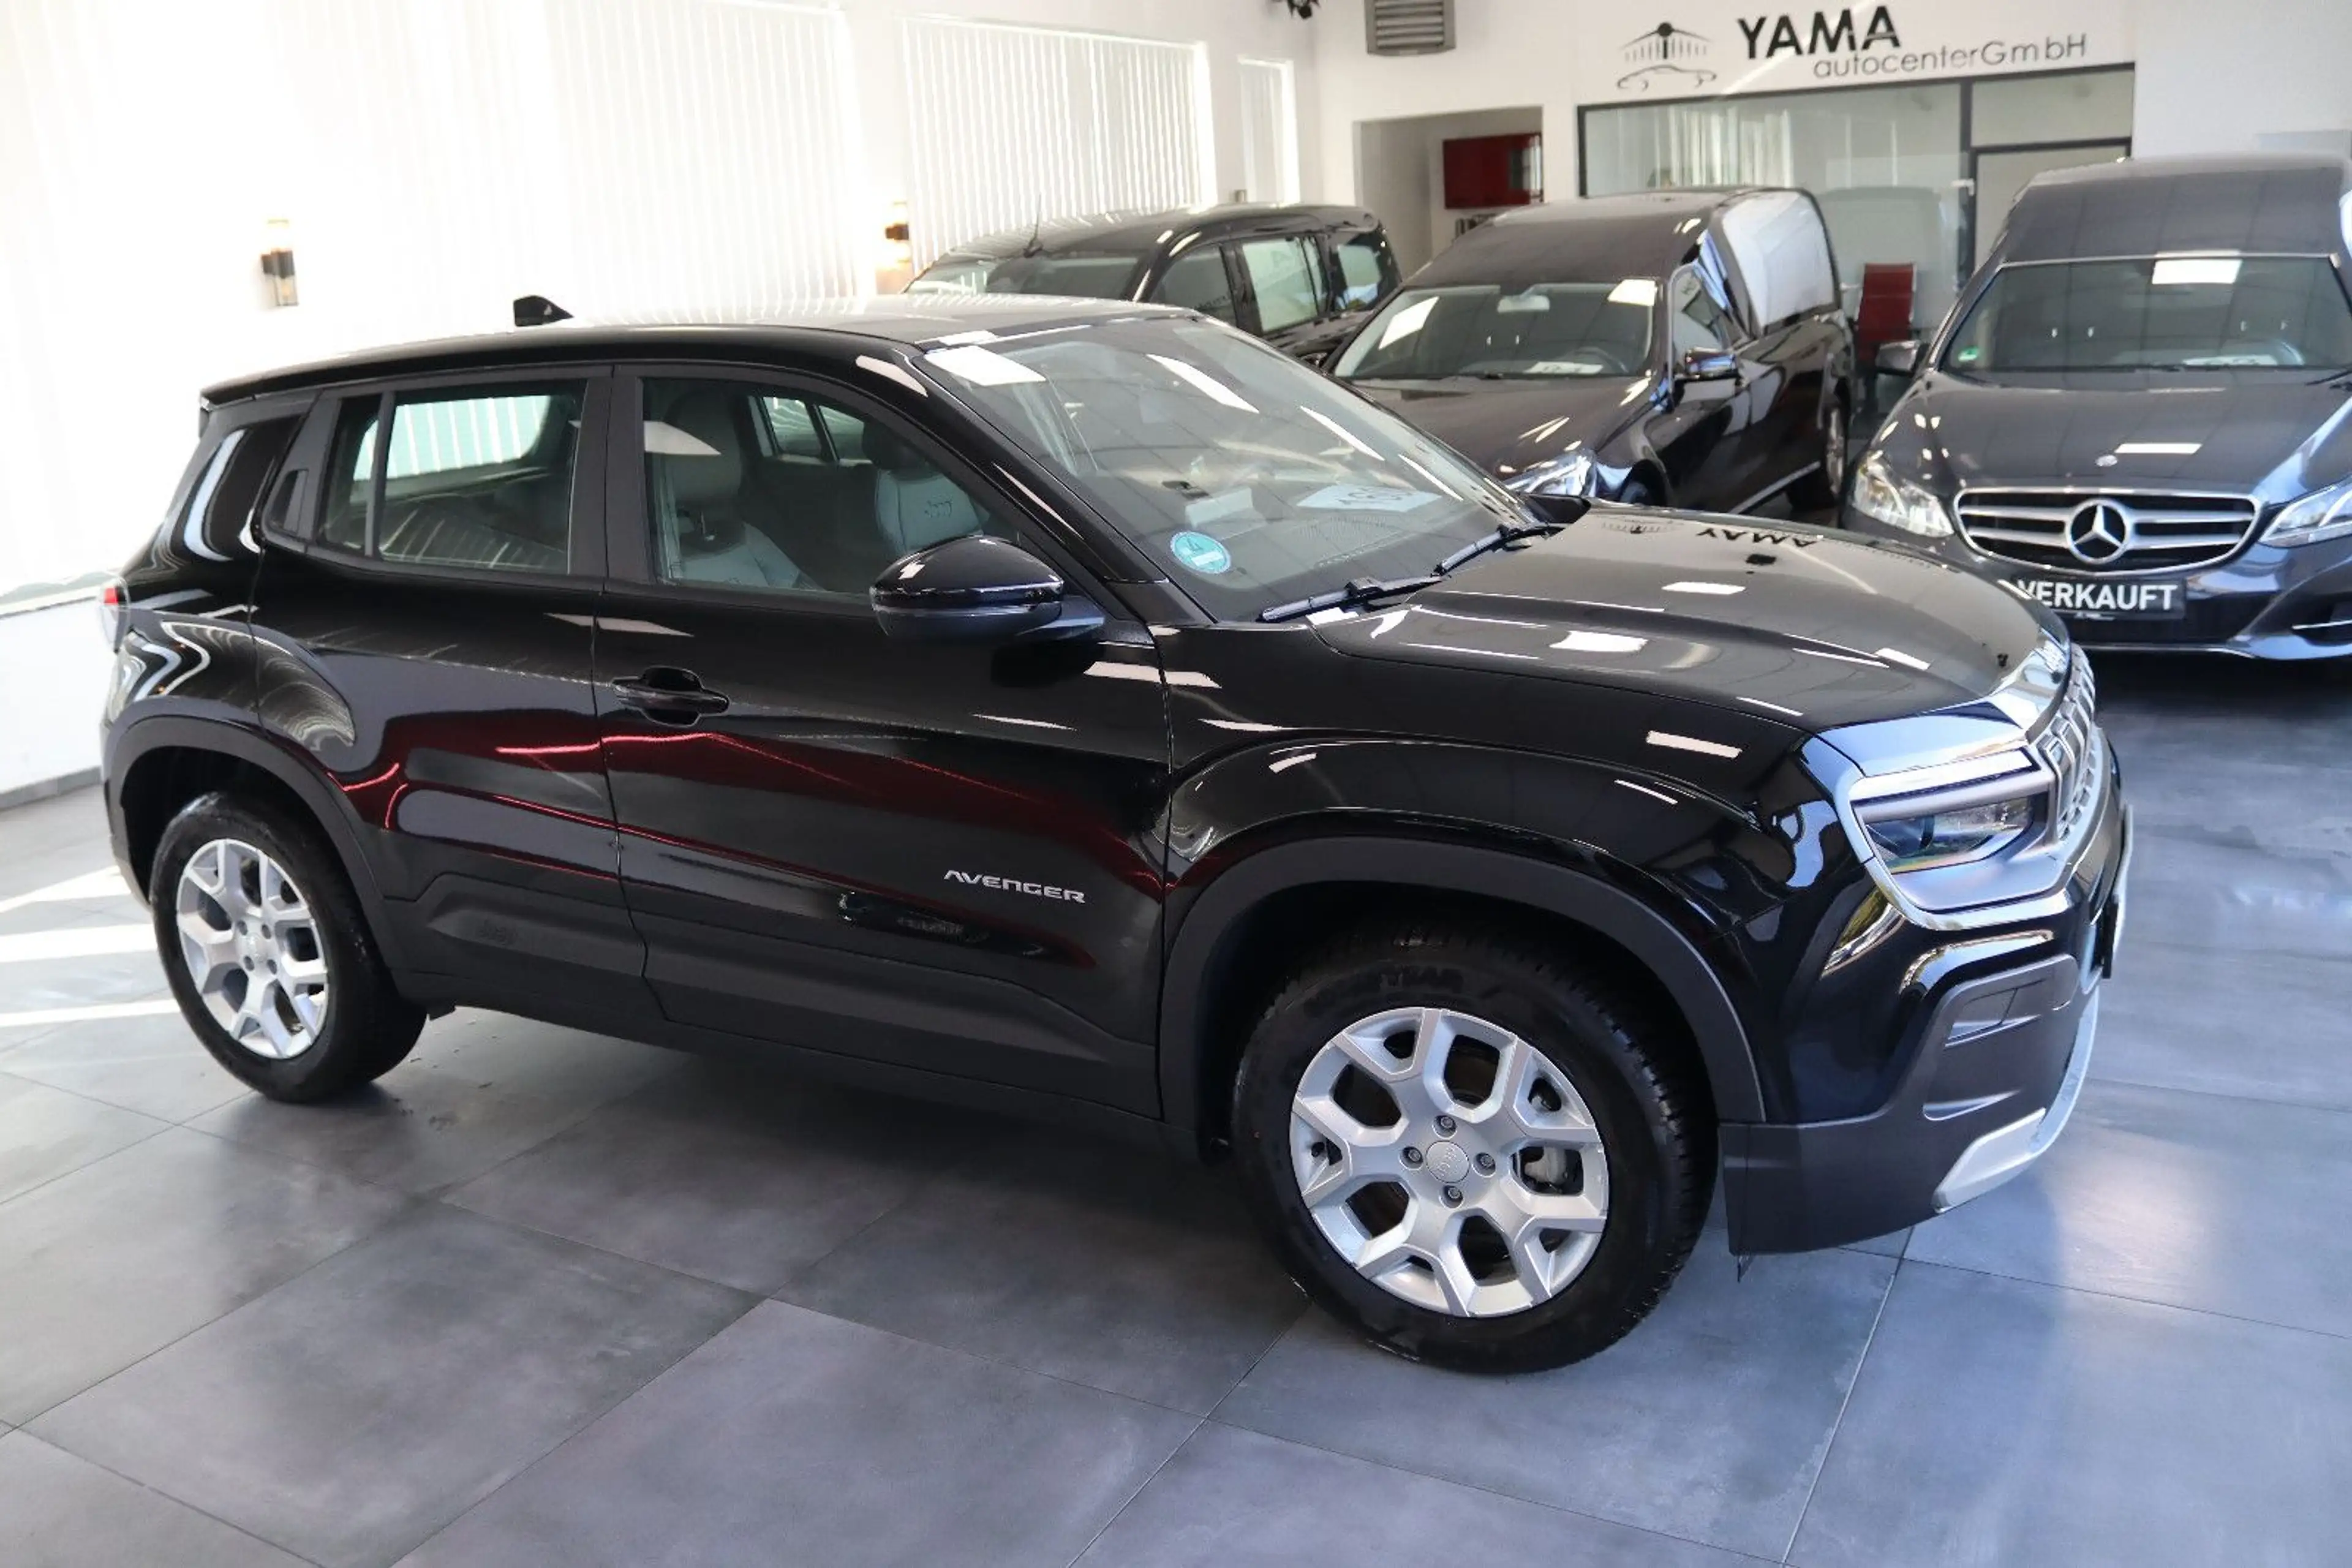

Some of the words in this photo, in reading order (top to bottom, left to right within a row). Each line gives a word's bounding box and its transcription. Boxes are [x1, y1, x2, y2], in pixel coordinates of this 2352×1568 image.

[1736, 5, 1901, 59] YAMA
[2017, 579, 2178, 611] VERKAUFT
[943, 869, 1086, 904] AVENGER
